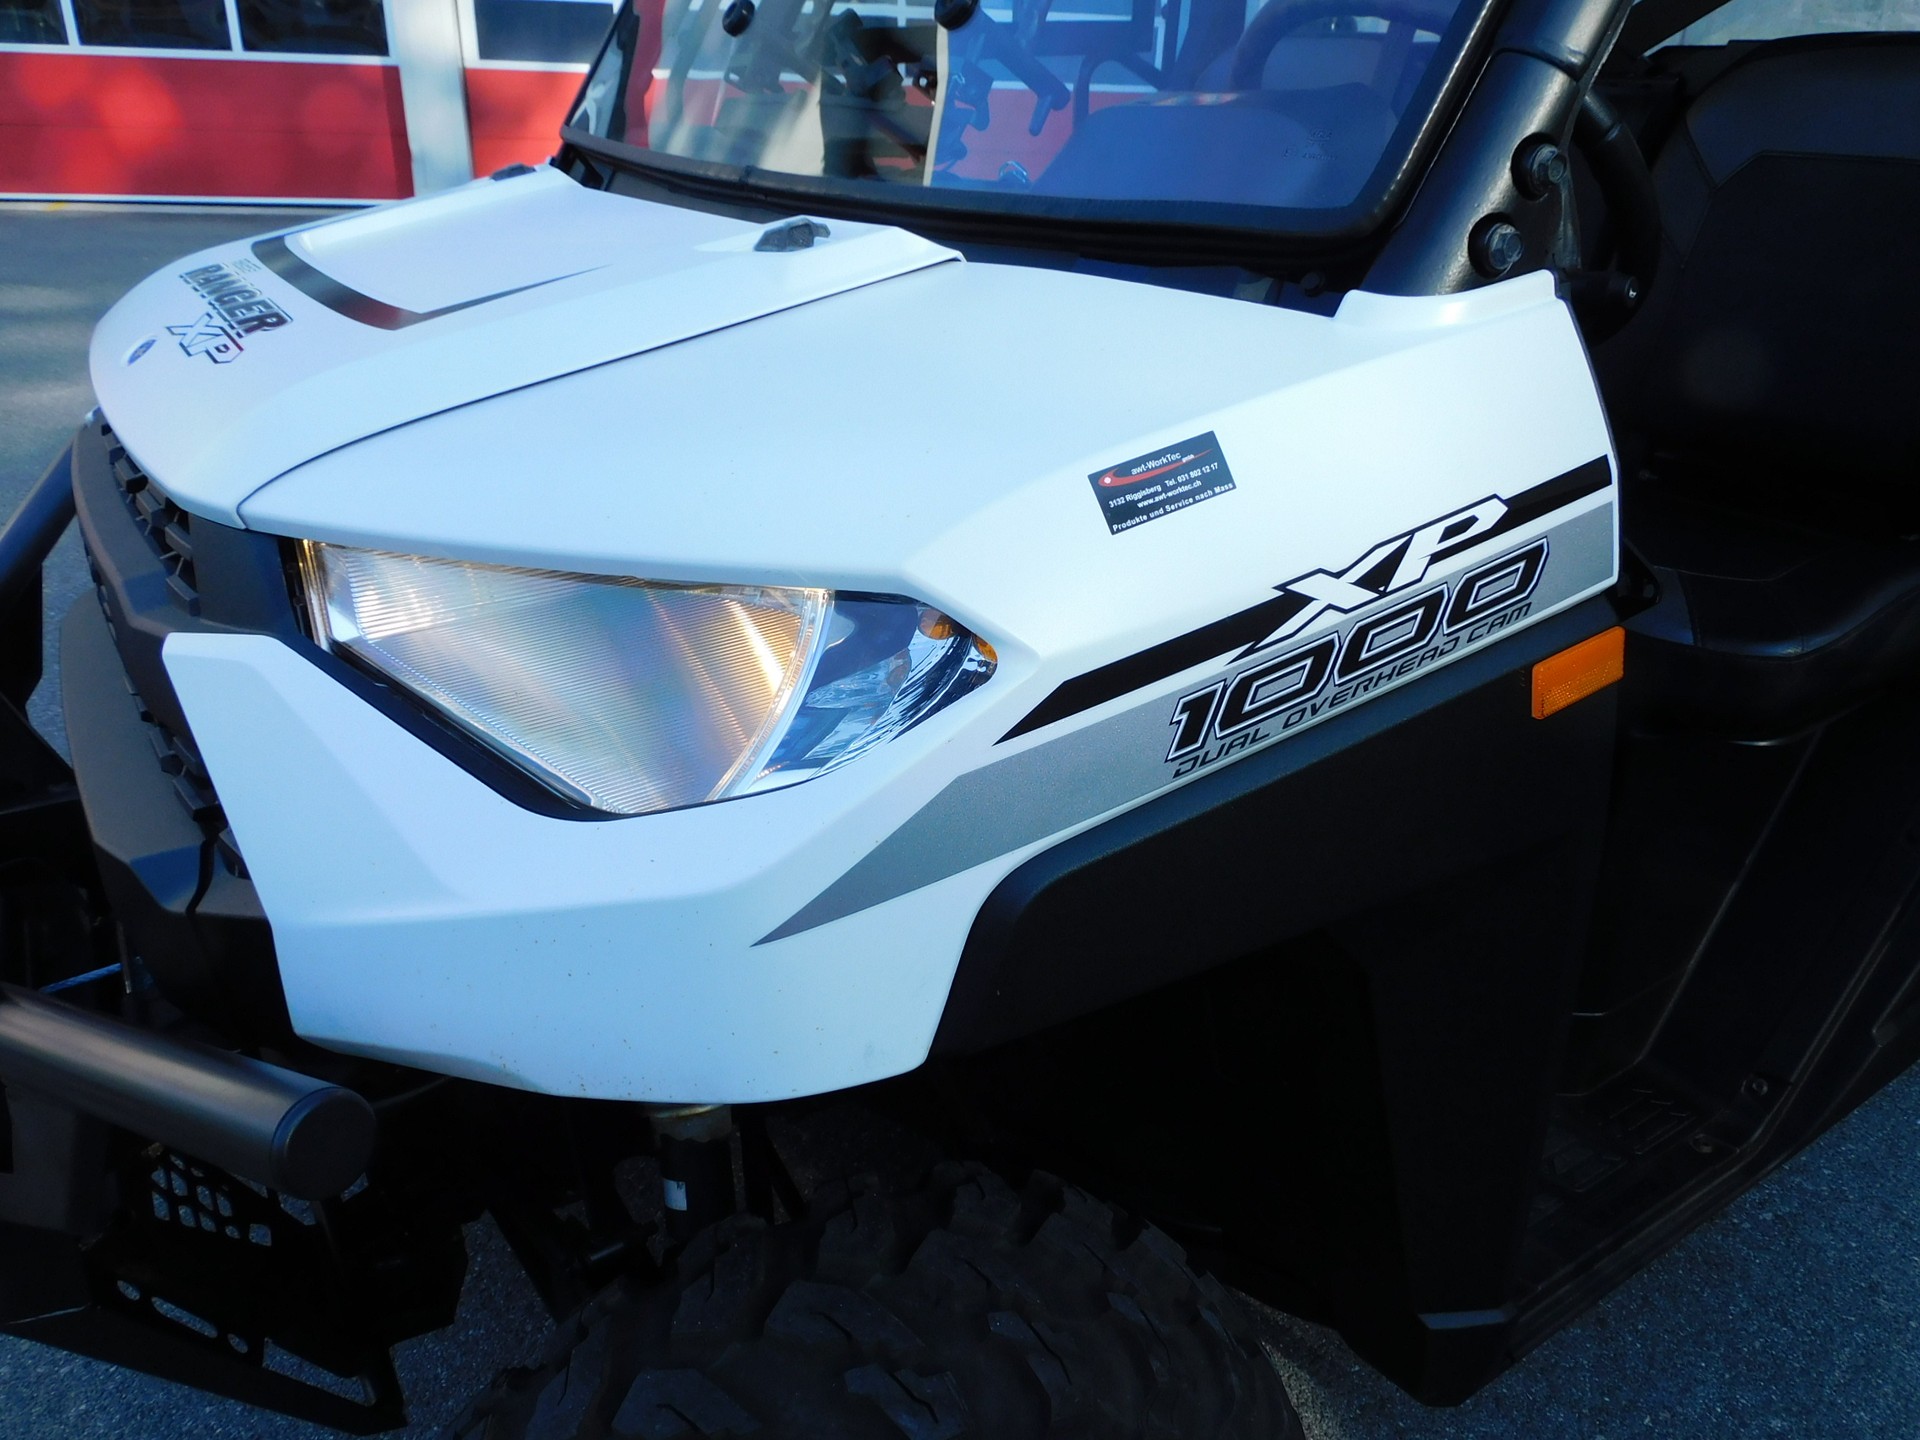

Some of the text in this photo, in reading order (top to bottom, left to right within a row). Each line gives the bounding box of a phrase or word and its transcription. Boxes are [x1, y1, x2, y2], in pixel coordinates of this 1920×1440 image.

[179, 263, 293, 339] RANGER
[166, 311, 244, 364] XP
[1108, 462, 1219, 508] 3132 Riggisberg Tel. 031 802 12 17
[1130, 451, 1182, 476] awt-WorkTec
[1112, 483, 1234, 532] Produkte und Service nach Mass
[1137, 480, 1202, 509] www.awt-worktec.ch
[1223, 493, 1509, 667] XP
[1165, 536, 1549, 762] 1000
[1172, 601, 1532, 779] DUAL OVERHEAD CAM
